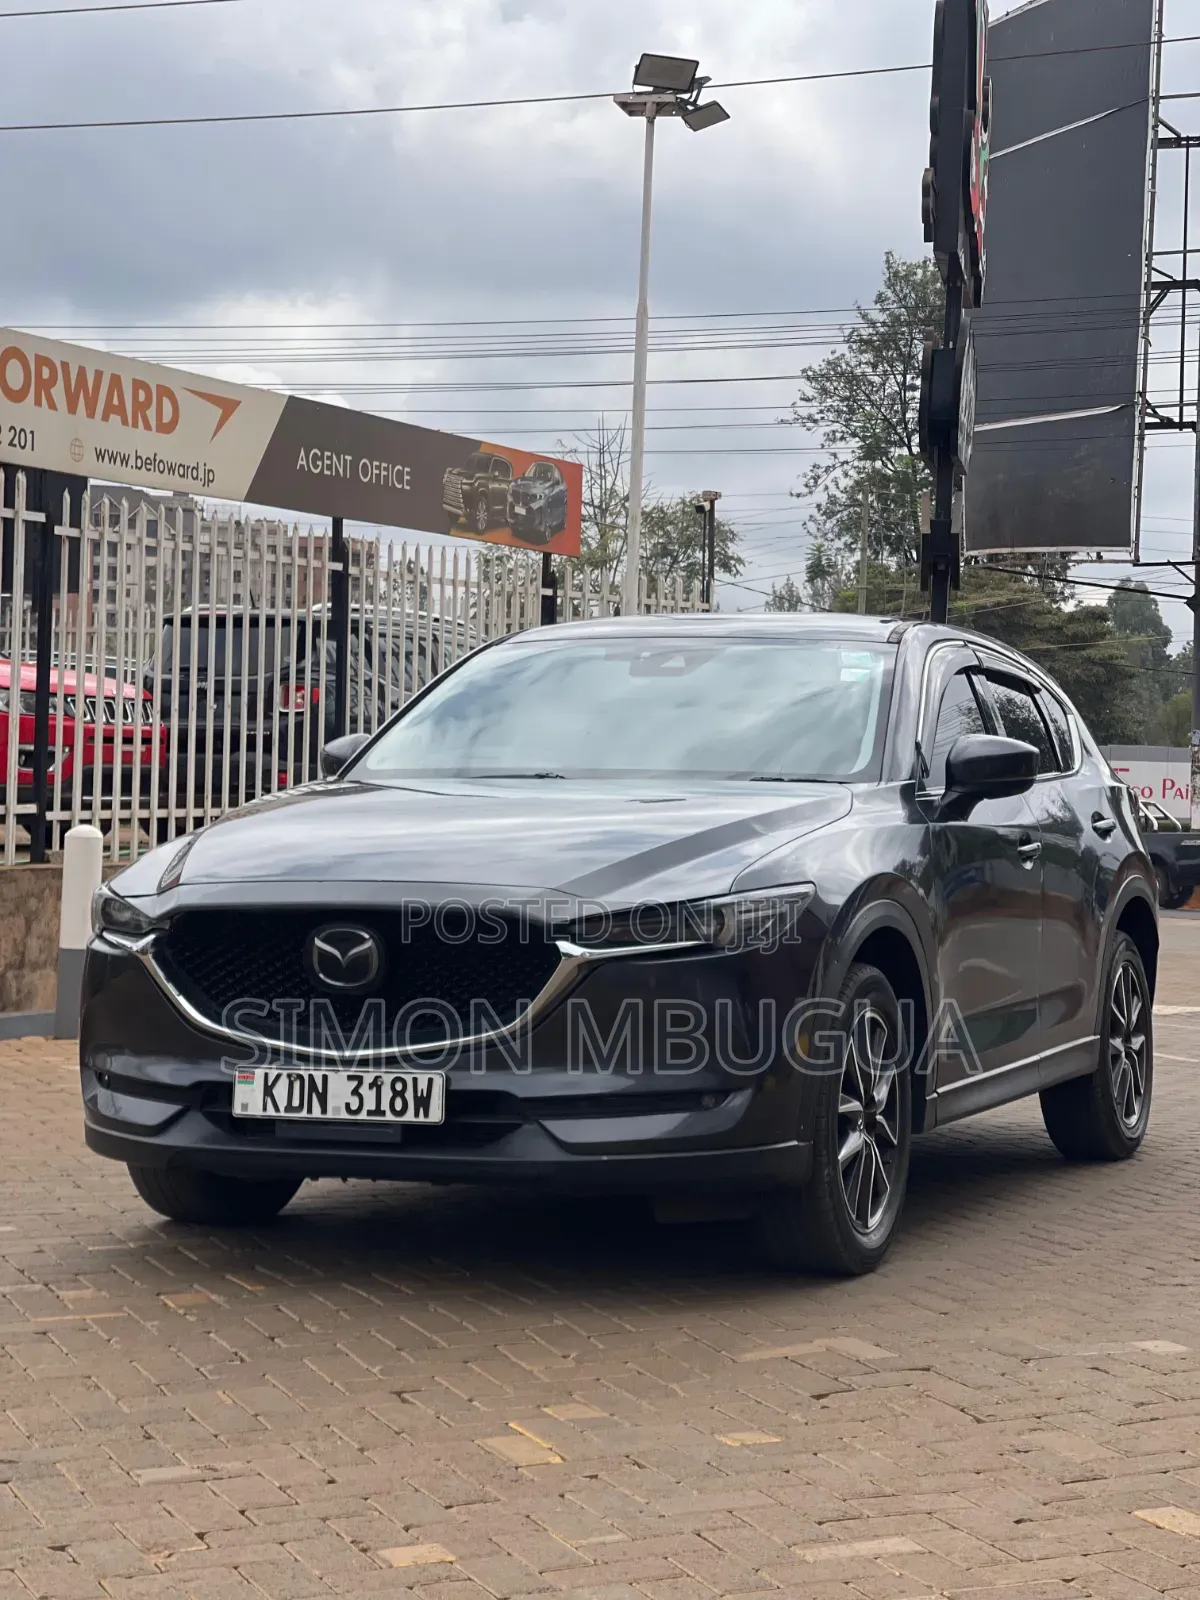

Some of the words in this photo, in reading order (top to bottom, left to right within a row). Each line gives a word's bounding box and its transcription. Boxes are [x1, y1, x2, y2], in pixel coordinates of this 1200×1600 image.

[0, 346, 180, 435] ORWARD
[8, 425, 35, 452] 201
[94, 446, 215, 488] www.befoward.jp
[296, 446, 353, 479] AGENT
[358, 458, 411, 490] OFFICE
[262, 1072, 328, 1115] KDN
[344, 1074, 434, 1119] 318W
